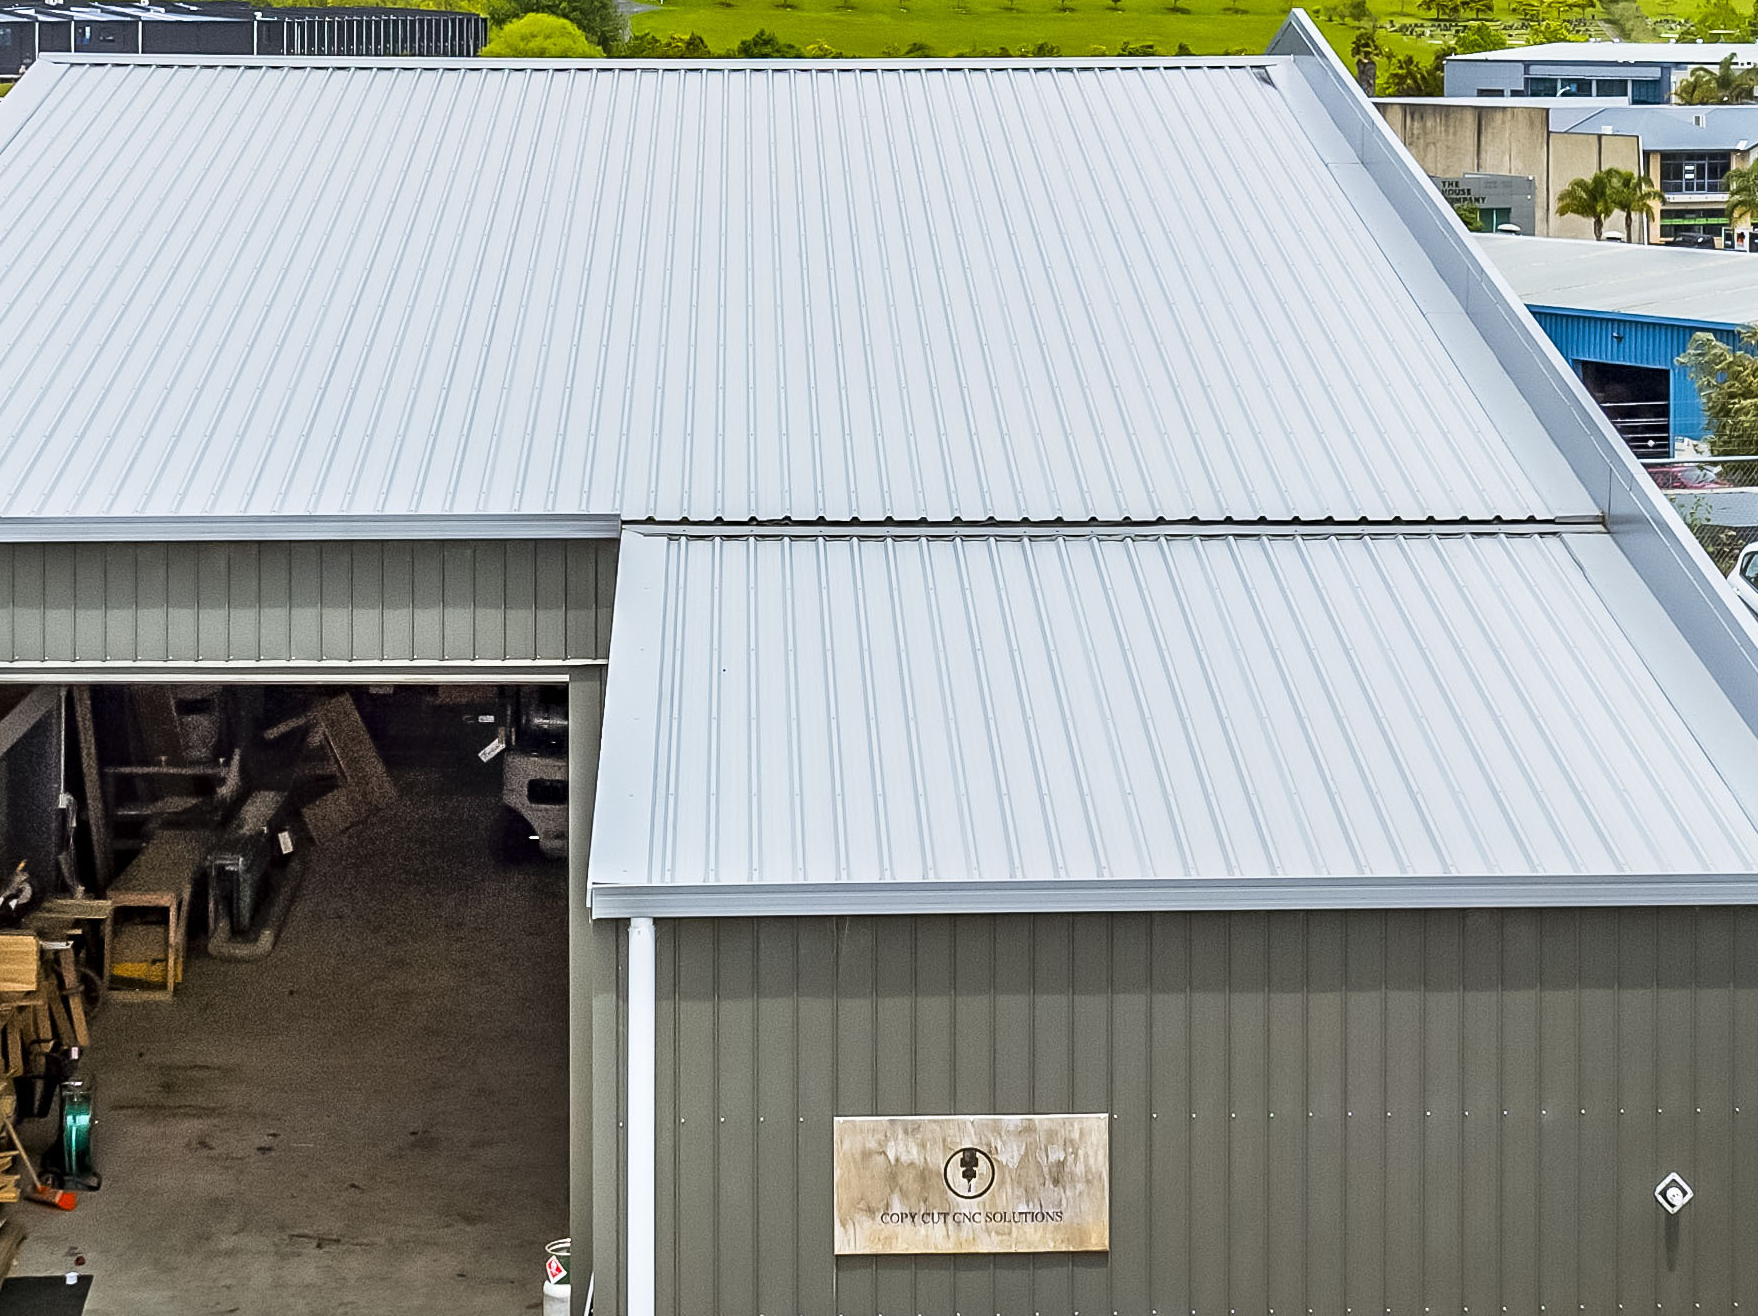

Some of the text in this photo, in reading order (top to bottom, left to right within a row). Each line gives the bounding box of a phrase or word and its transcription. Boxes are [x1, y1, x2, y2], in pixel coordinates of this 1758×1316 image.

[1441, 180, 1460, 188] THE
[880, 1211, 1064, 1225] COPY CUT CNC SOLUTIONS
